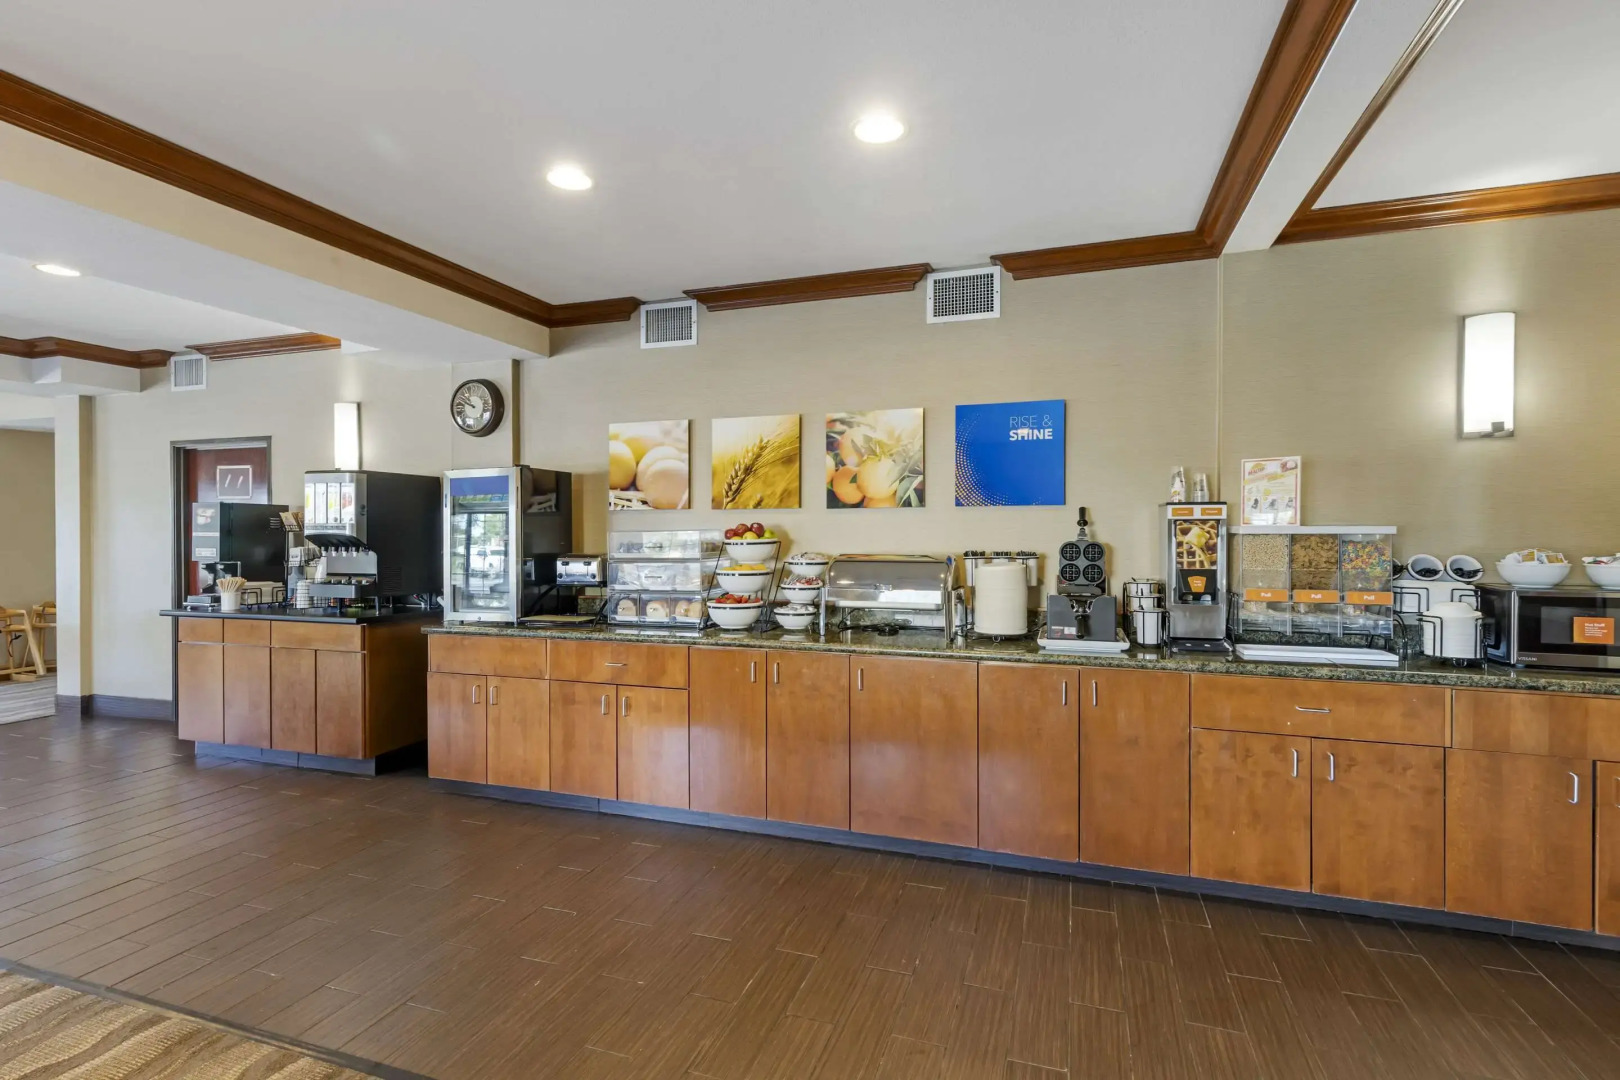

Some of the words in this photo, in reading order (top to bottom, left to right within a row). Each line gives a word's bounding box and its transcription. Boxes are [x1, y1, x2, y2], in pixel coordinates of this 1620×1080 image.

[1009, 416, 1037, 428] RISE
[1042, 414, 1053, 427] &
[1009, 428, 1053, 441] SHINE
